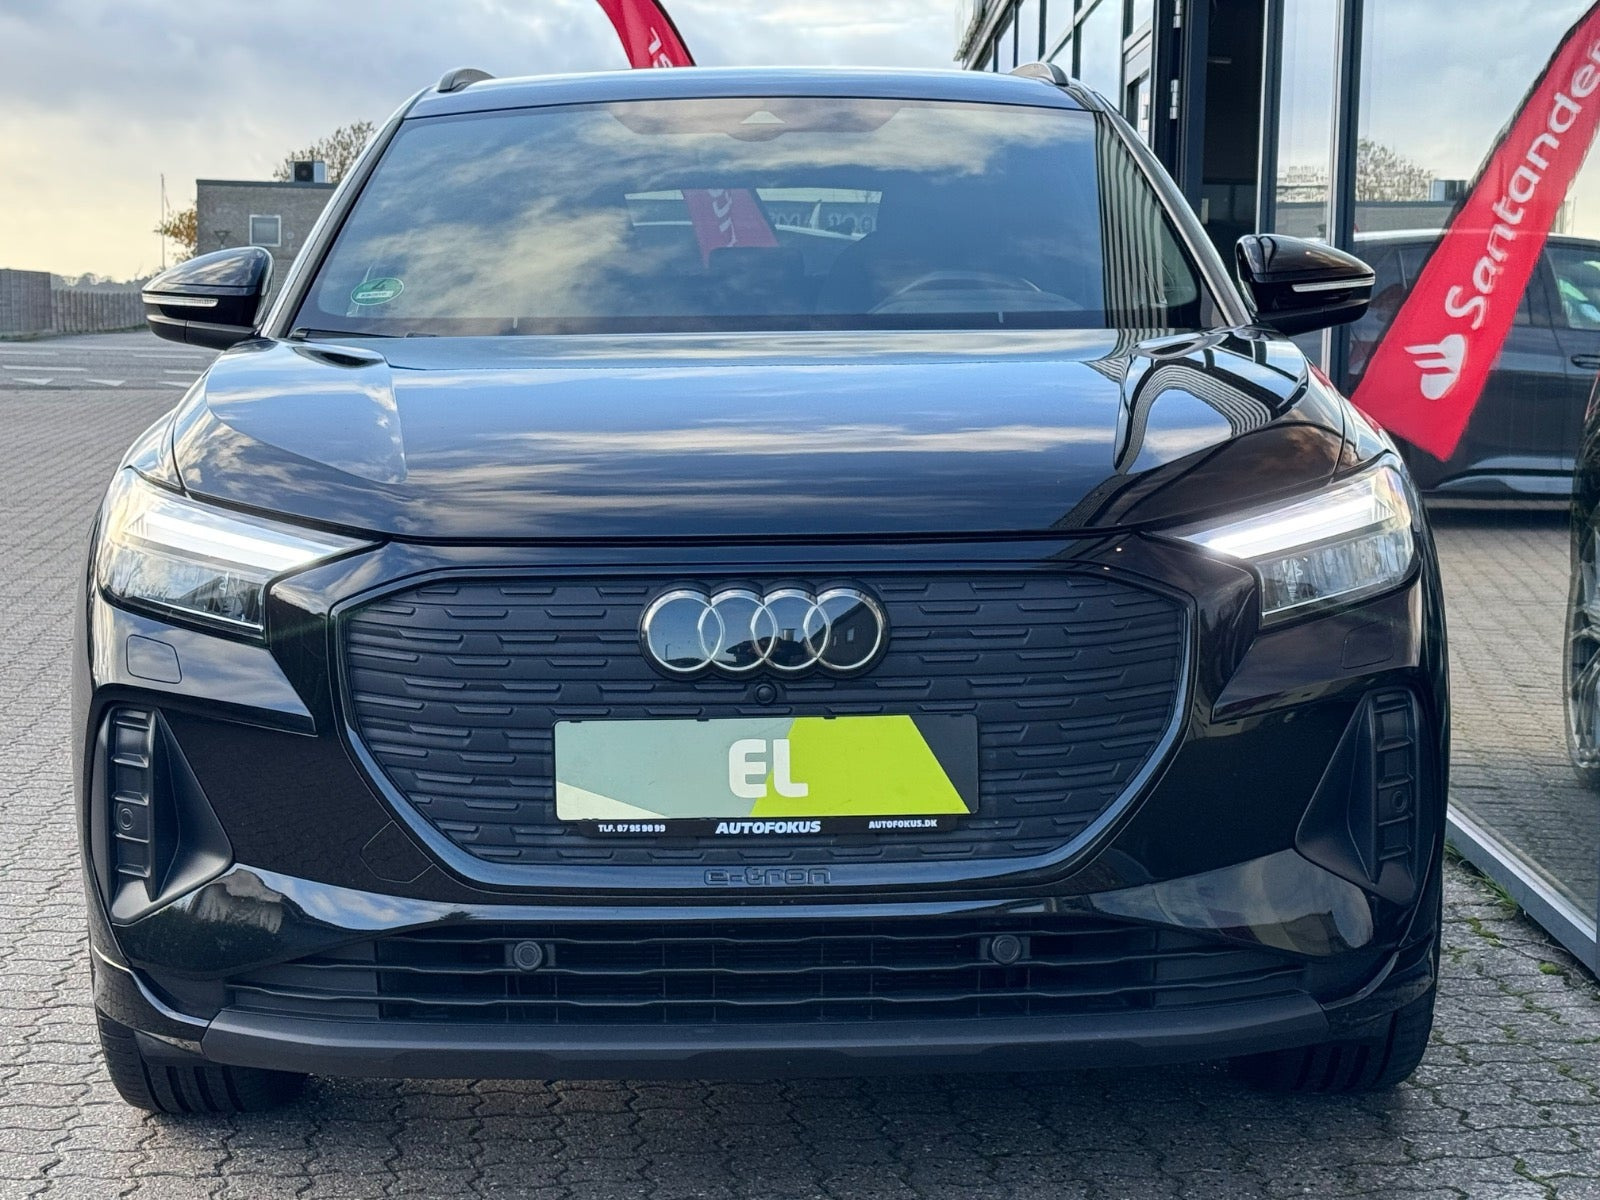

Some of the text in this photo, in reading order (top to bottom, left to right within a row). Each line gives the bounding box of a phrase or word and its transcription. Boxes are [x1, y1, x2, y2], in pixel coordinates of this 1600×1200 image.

[729, 739, 809, 799] EL
[598, 824, 616, 833] TLF.
[715, 821, 821, 835] AUTOFOKUS
[868, 819, 938, 830] AUTOFOKUS.DK
[703, 866, 832, 886] e-tron
